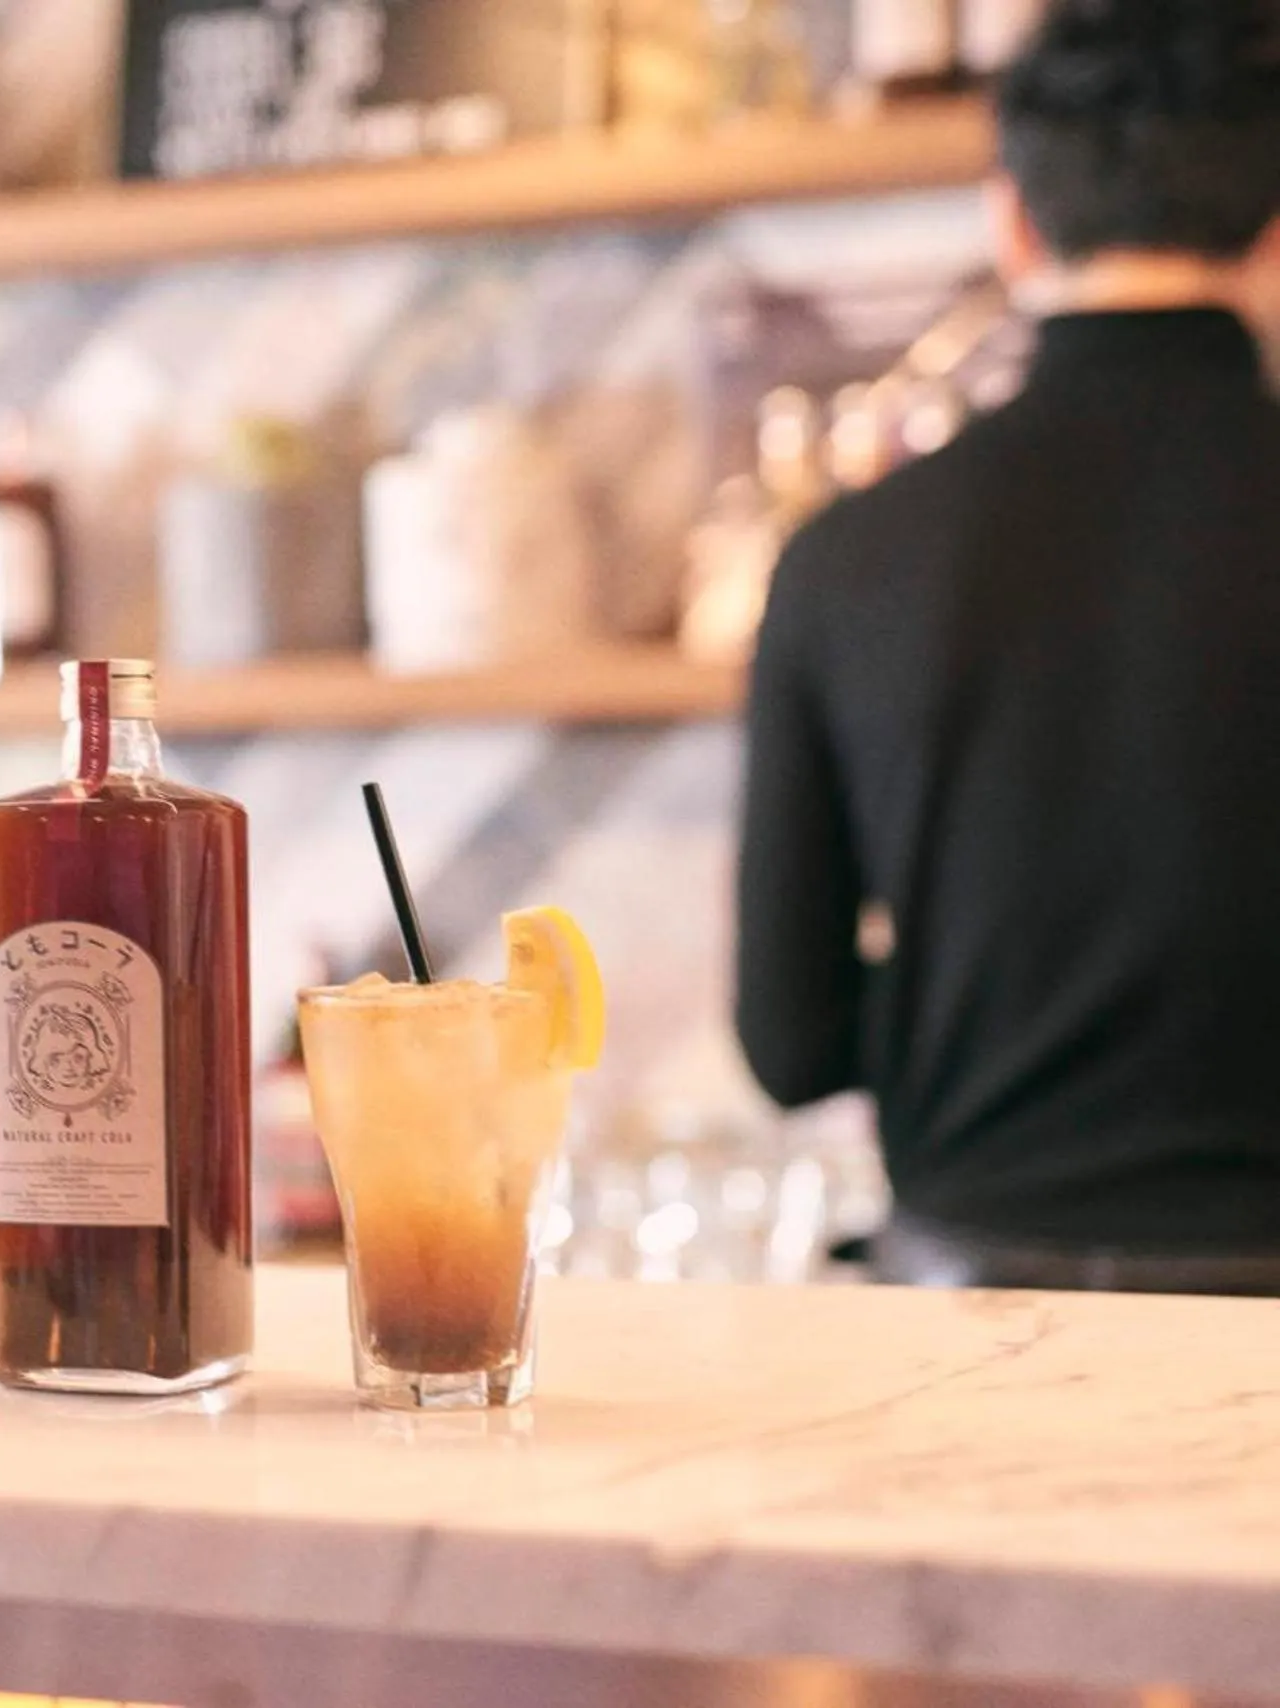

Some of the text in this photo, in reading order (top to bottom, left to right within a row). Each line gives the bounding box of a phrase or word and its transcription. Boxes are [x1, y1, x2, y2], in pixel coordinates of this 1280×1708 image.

[0, 930, 134, 971] ともコーラ
[2, 1129, 132, 1144] NATURAL CRAFT COLA
